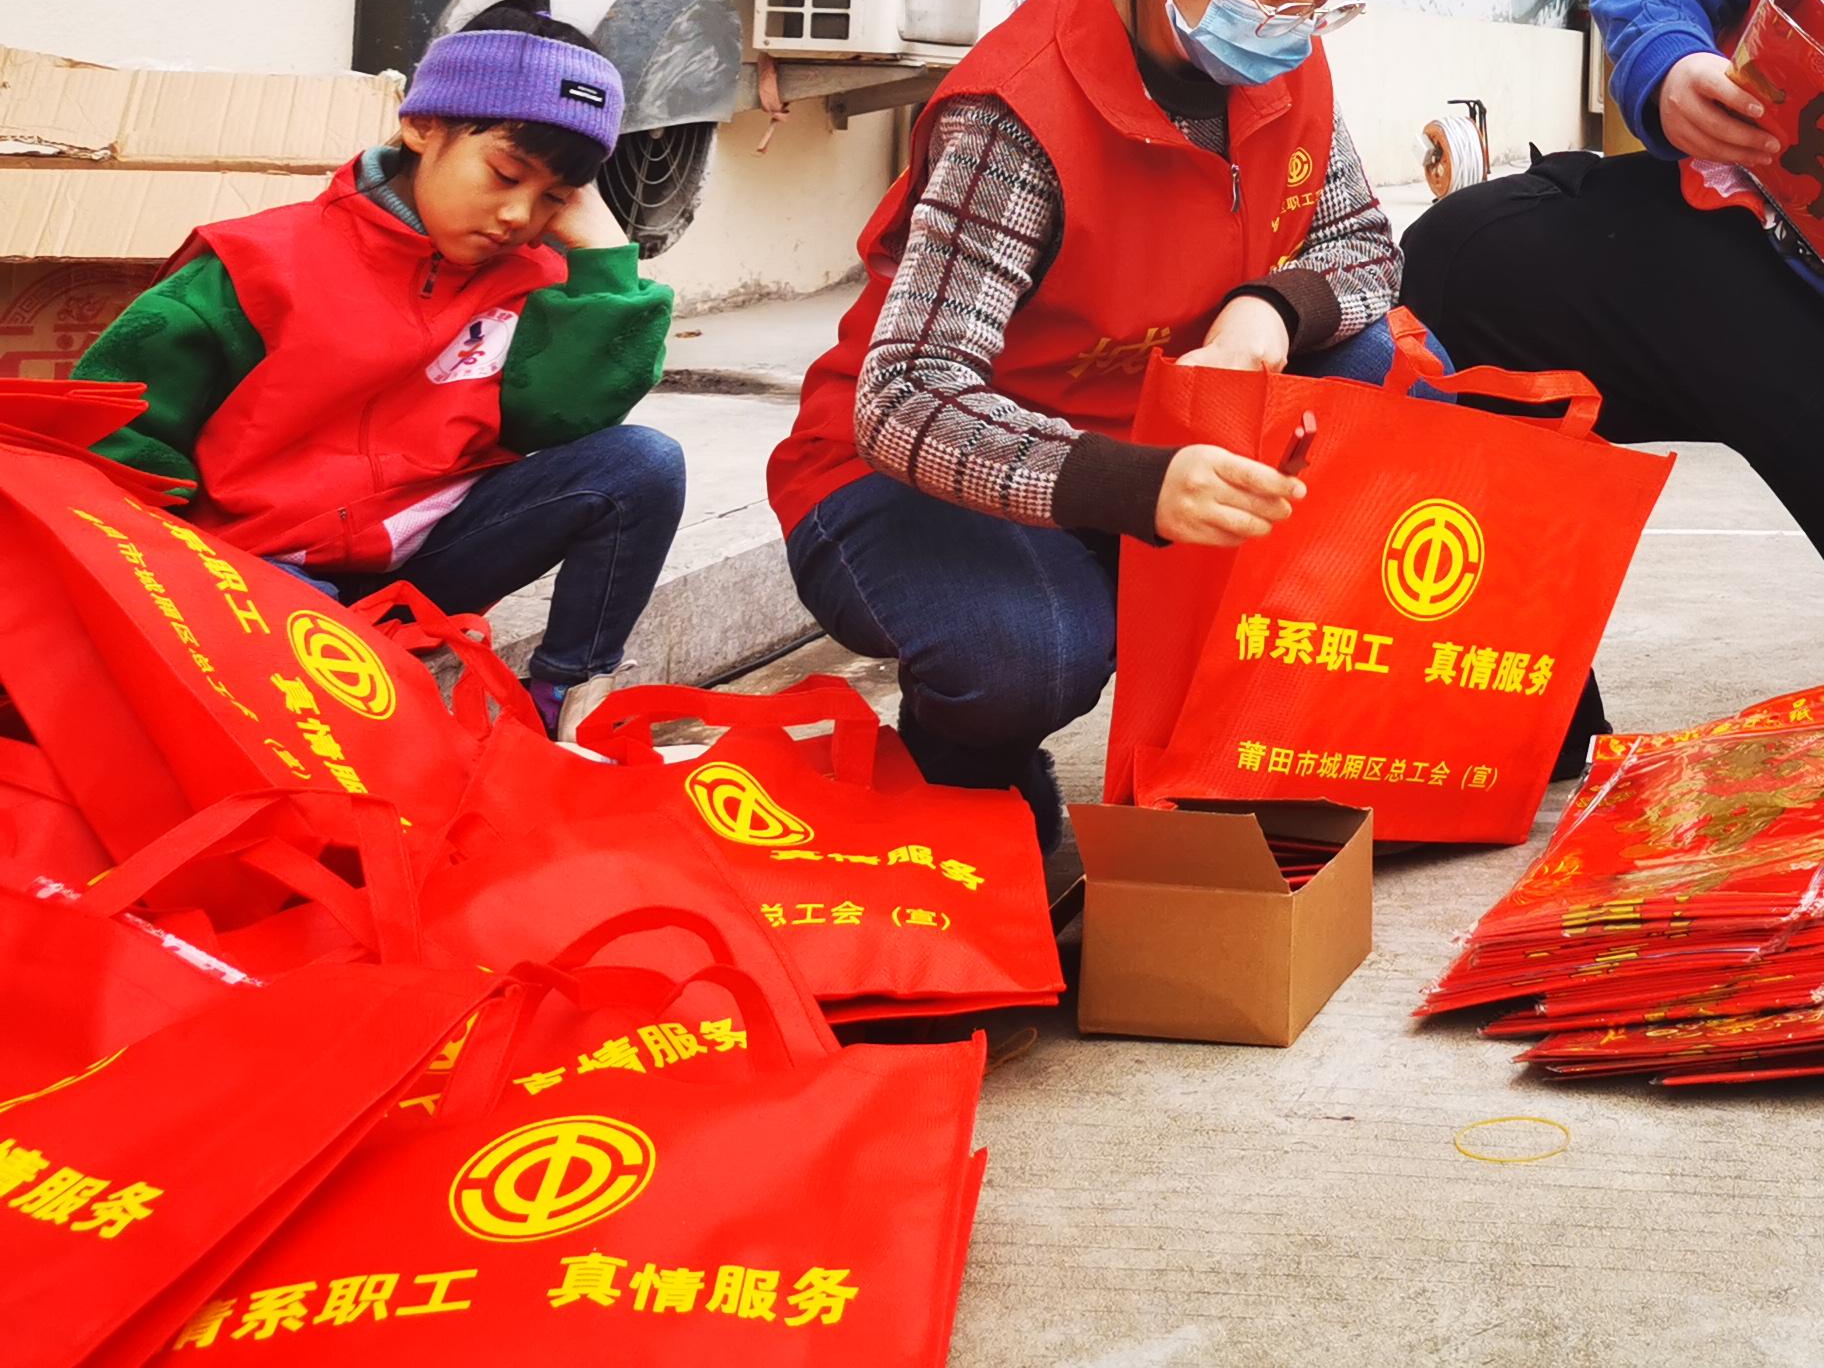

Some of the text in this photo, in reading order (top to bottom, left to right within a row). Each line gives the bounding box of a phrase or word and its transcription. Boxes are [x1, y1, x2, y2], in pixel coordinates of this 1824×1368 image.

[124, 497, 388, 812] 系职工 真情服
[1235, 613, 1556, 697] 情系职工 真情服务
[546, 1252, 860, 1327] 真情服务
